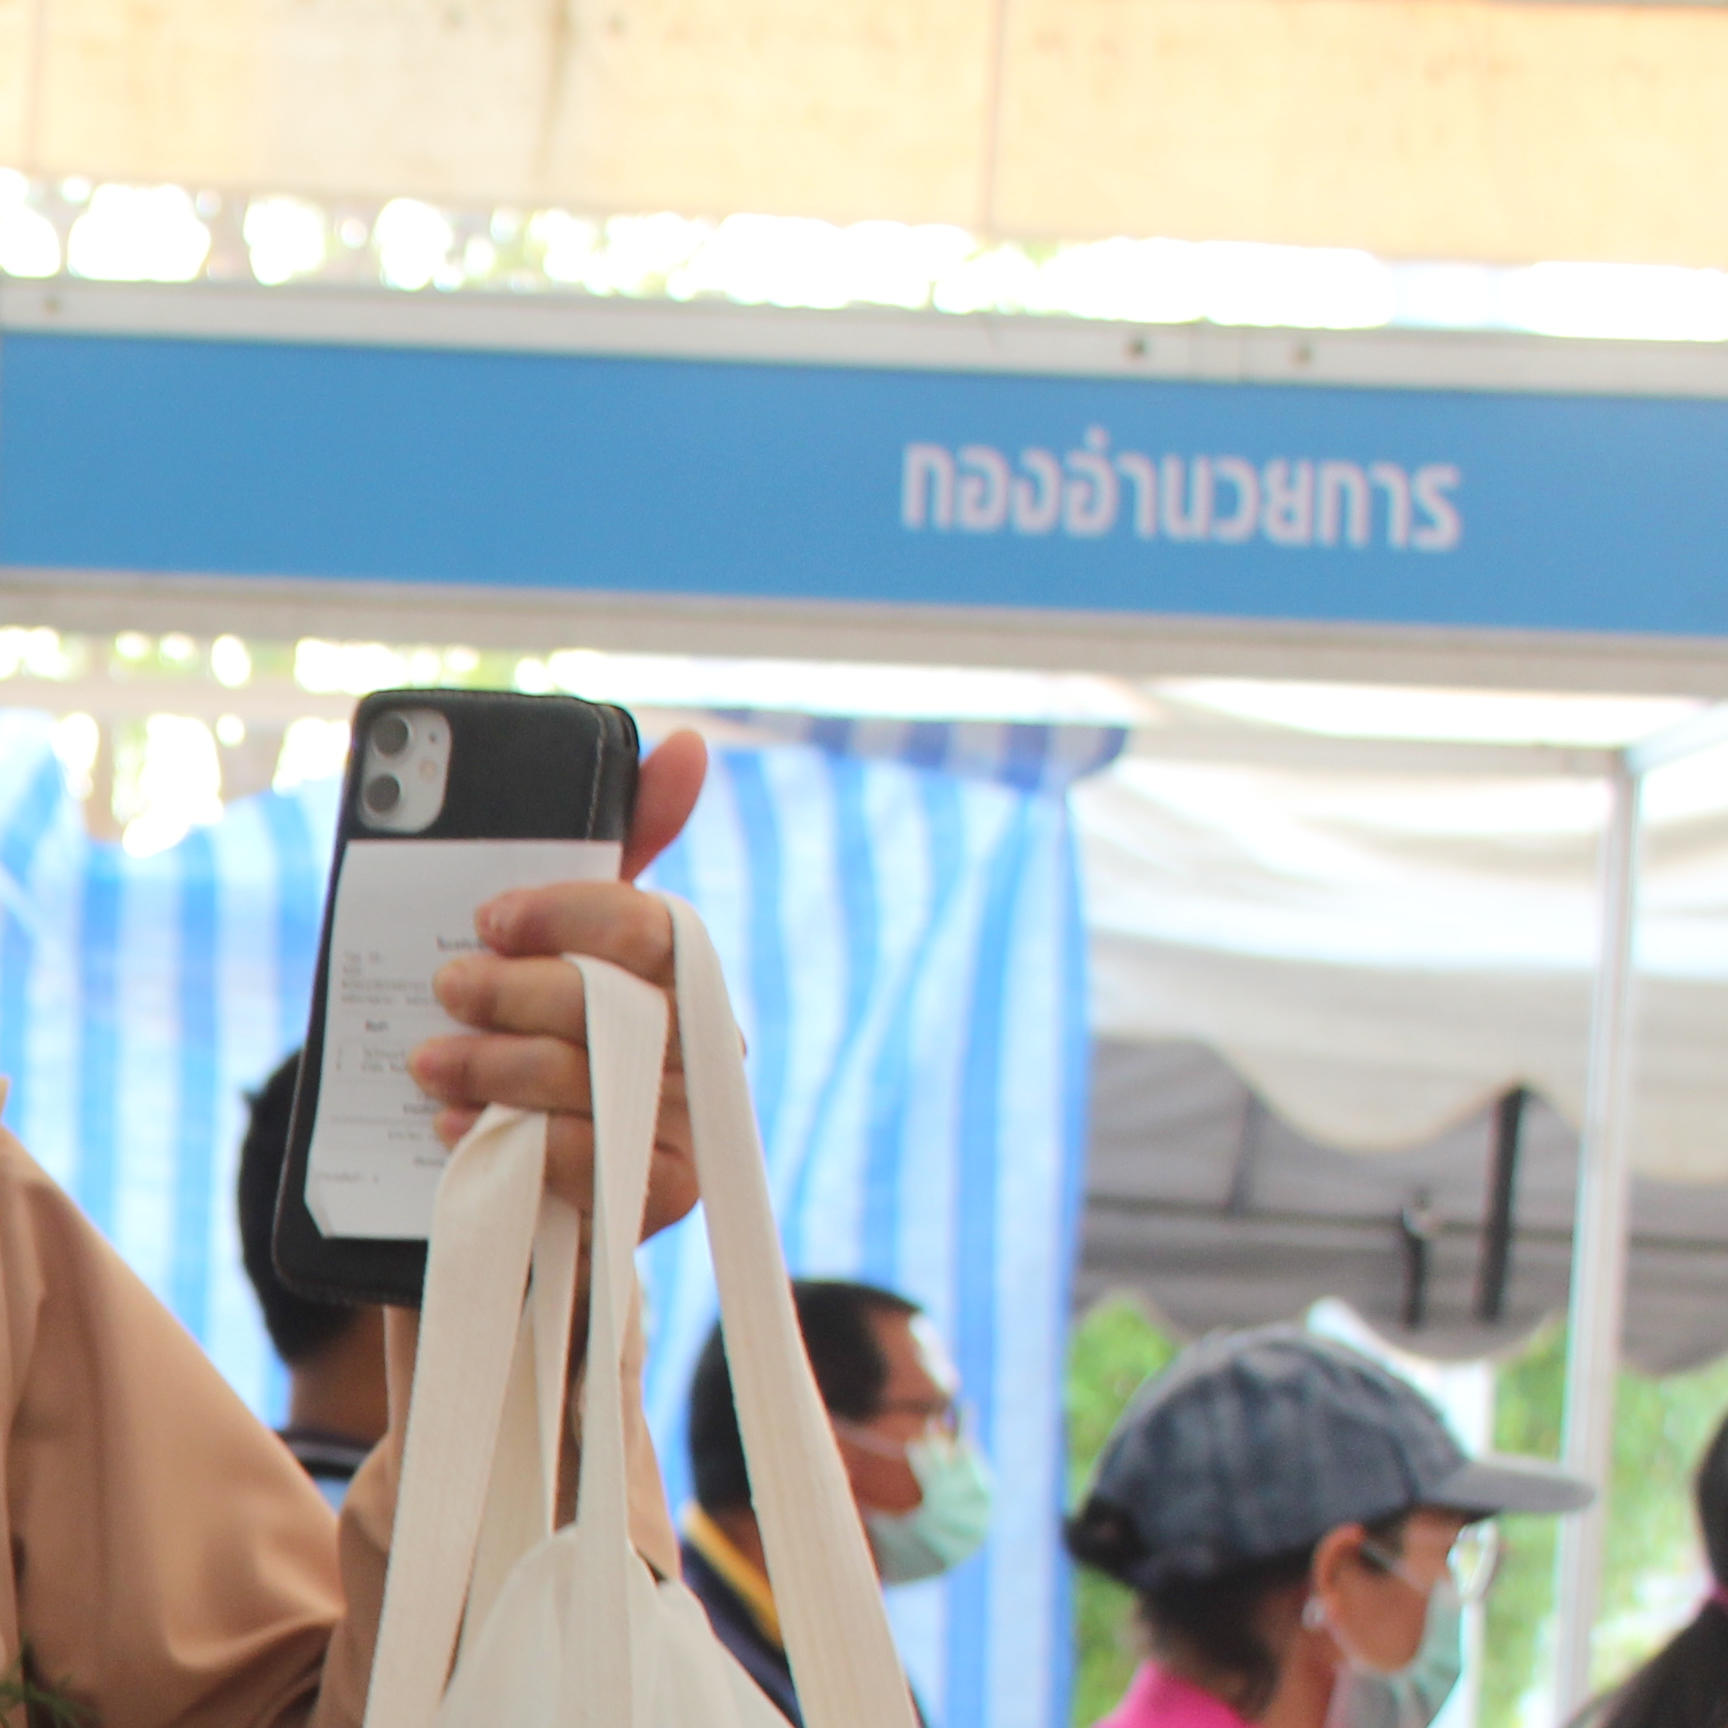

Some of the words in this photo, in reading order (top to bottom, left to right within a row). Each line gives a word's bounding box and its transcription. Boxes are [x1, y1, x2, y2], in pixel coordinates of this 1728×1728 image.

[901, 423, 1462, 552] กองอำนวยการ
